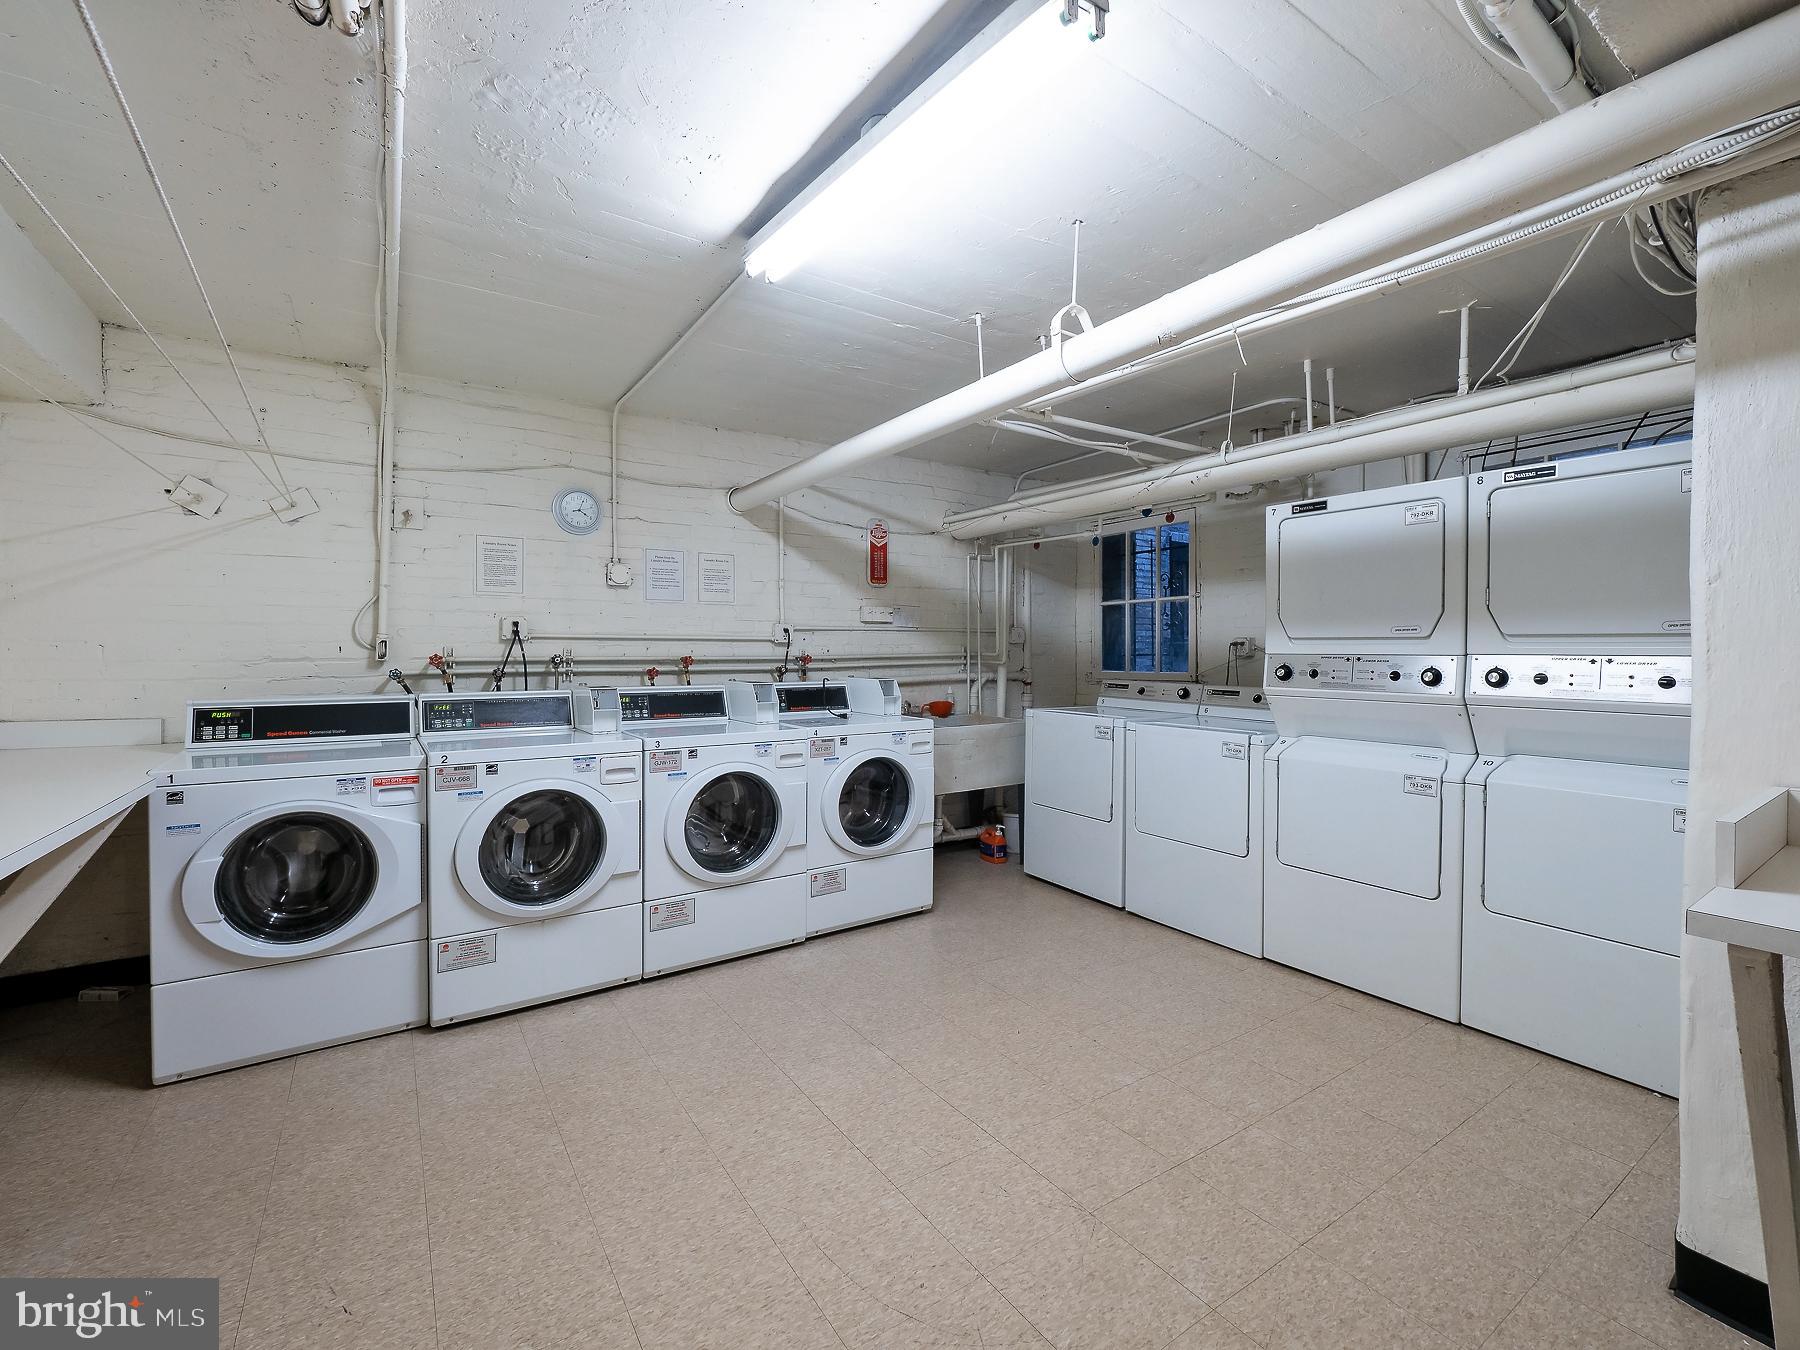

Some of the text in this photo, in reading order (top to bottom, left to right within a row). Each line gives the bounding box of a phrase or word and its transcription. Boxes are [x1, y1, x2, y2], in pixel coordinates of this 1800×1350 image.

[1477, 476, 1484, 484] 8
[655, 740, 660, 748] 3
[441, 754, 448, 763] 2
[166, 774, 174, 784] 1
